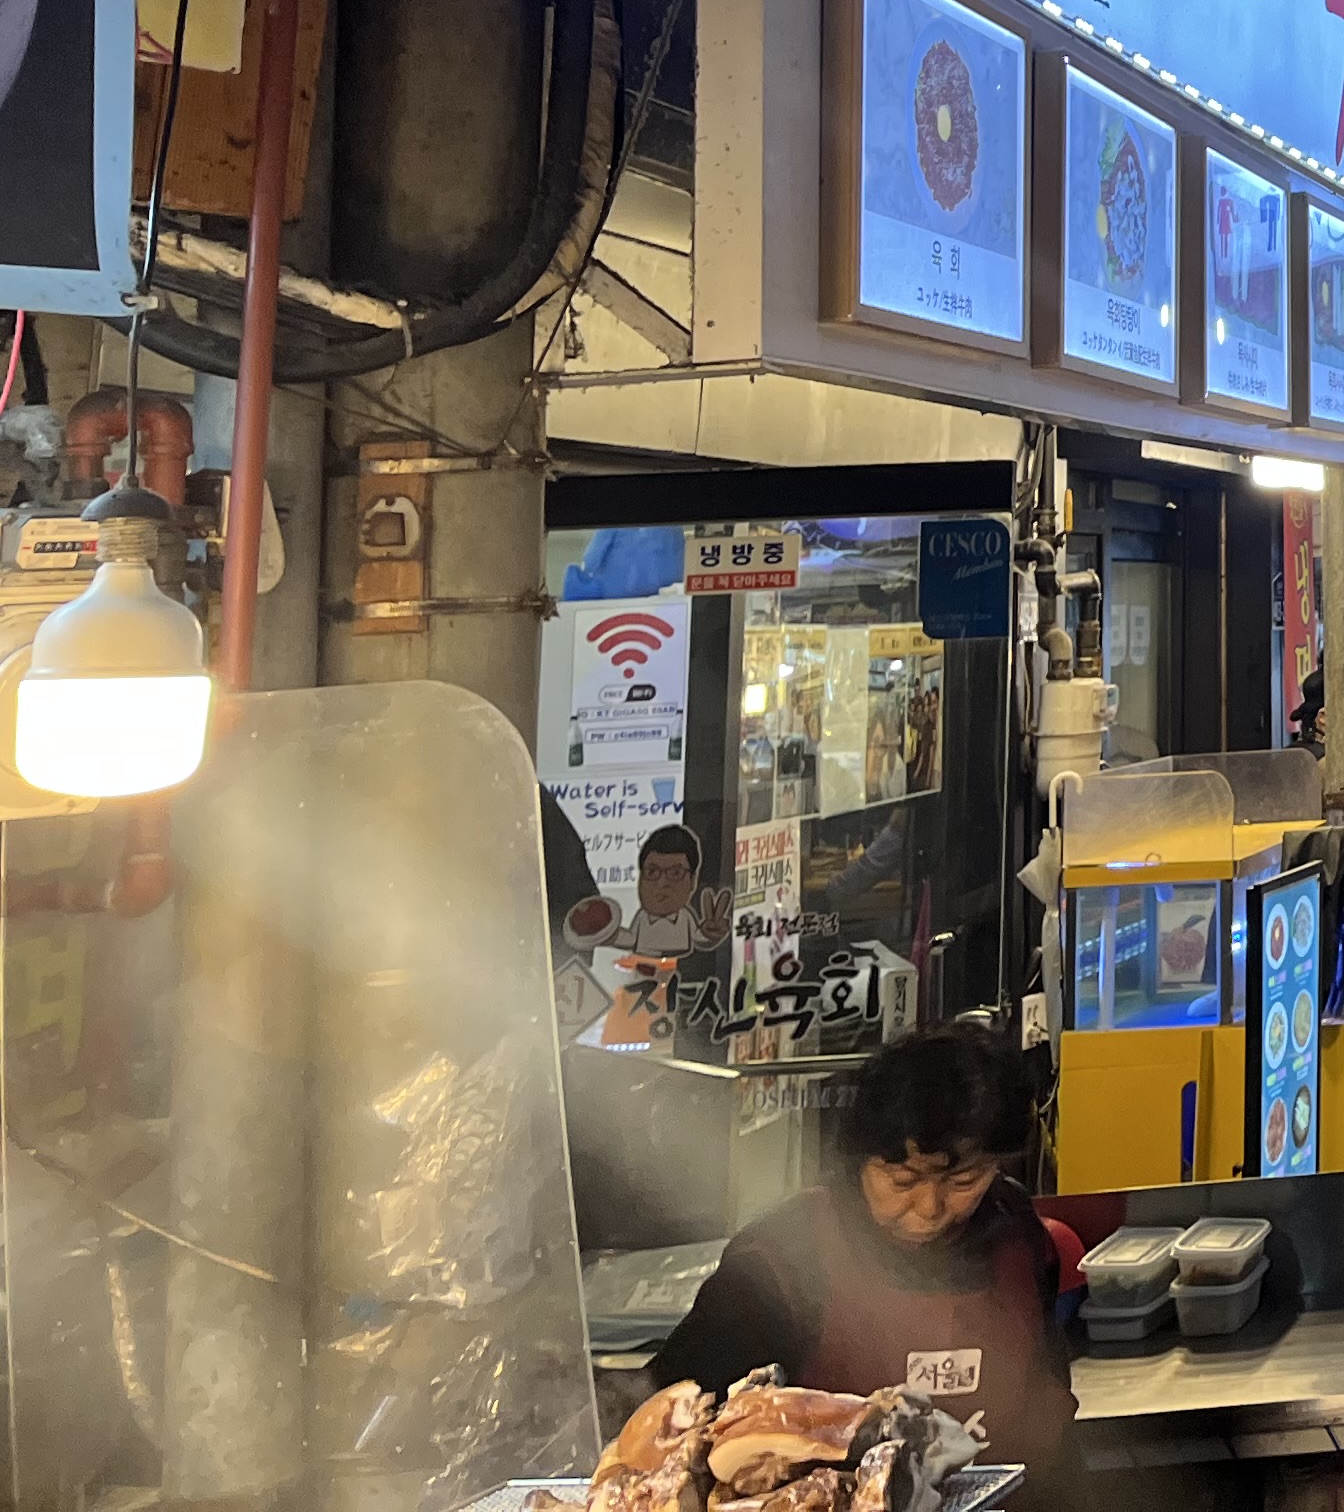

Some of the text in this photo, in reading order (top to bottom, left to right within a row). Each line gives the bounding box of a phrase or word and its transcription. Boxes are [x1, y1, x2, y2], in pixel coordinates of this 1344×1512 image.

[931, 240, 962, 280] 육회
[700, 541, 785, 567] 냉방중
[928, 531, 1001, 557] CESCO
[550, 779, 639, 800] Water is
[735, 912, 772, 941] 육회
